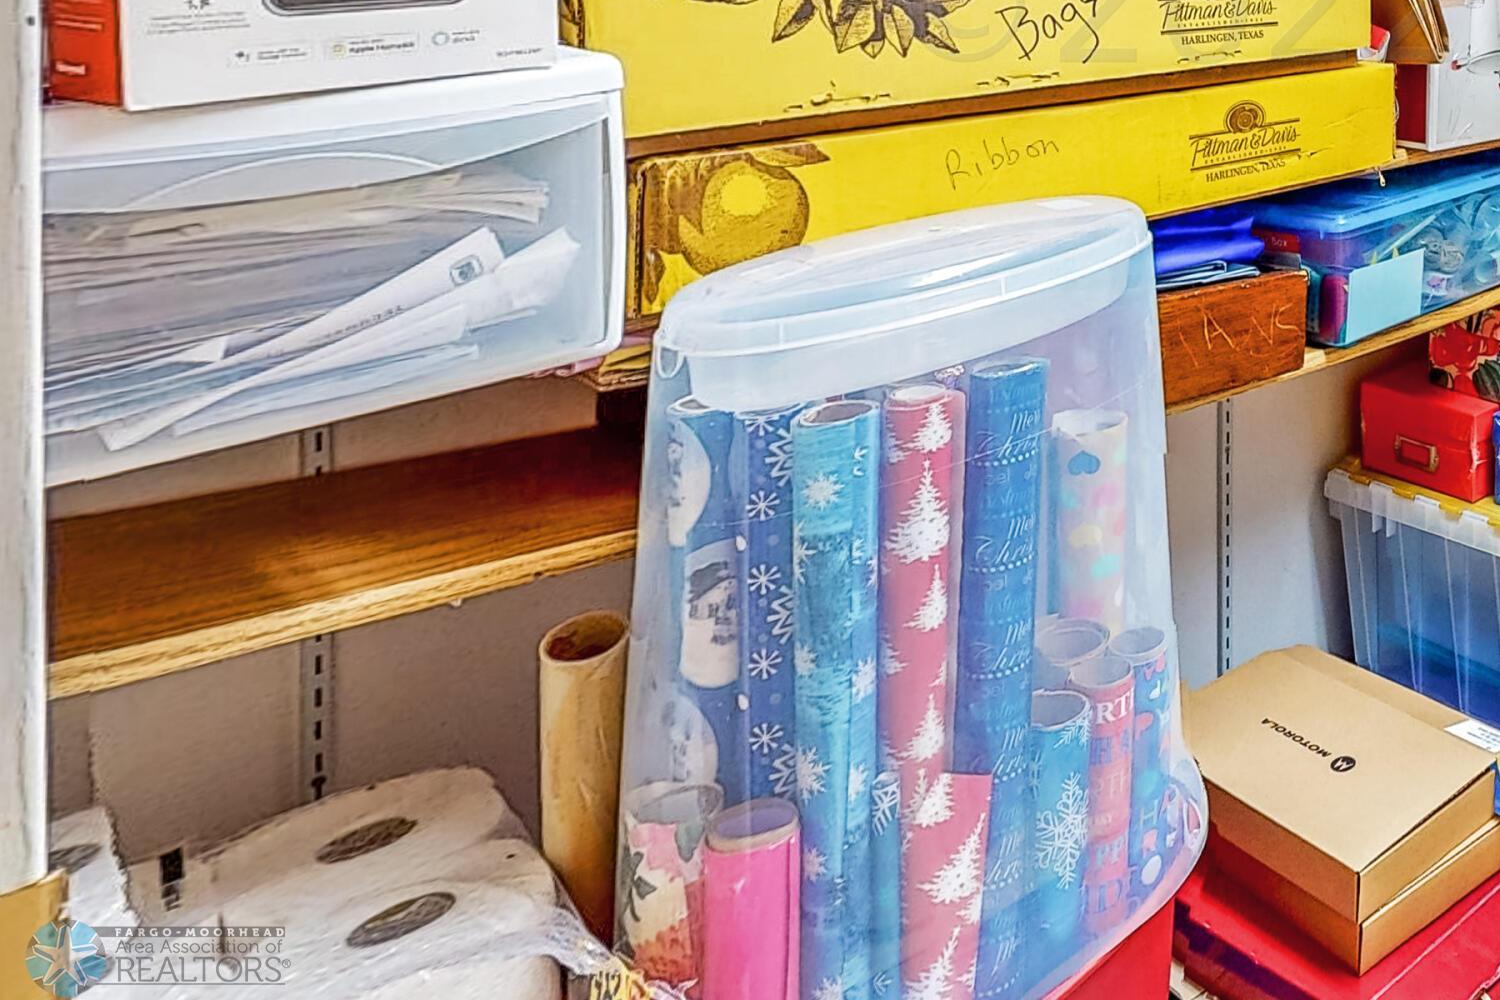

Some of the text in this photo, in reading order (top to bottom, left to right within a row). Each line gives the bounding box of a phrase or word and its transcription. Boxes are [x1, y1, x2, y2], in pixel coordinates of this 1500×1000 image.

[1181, 29, 1264, 46] HARLINGEN, TEXAS
[944, 136, 1060, 191] Ribbon
[1260, 716, 1332, 759] MOTOROLA
